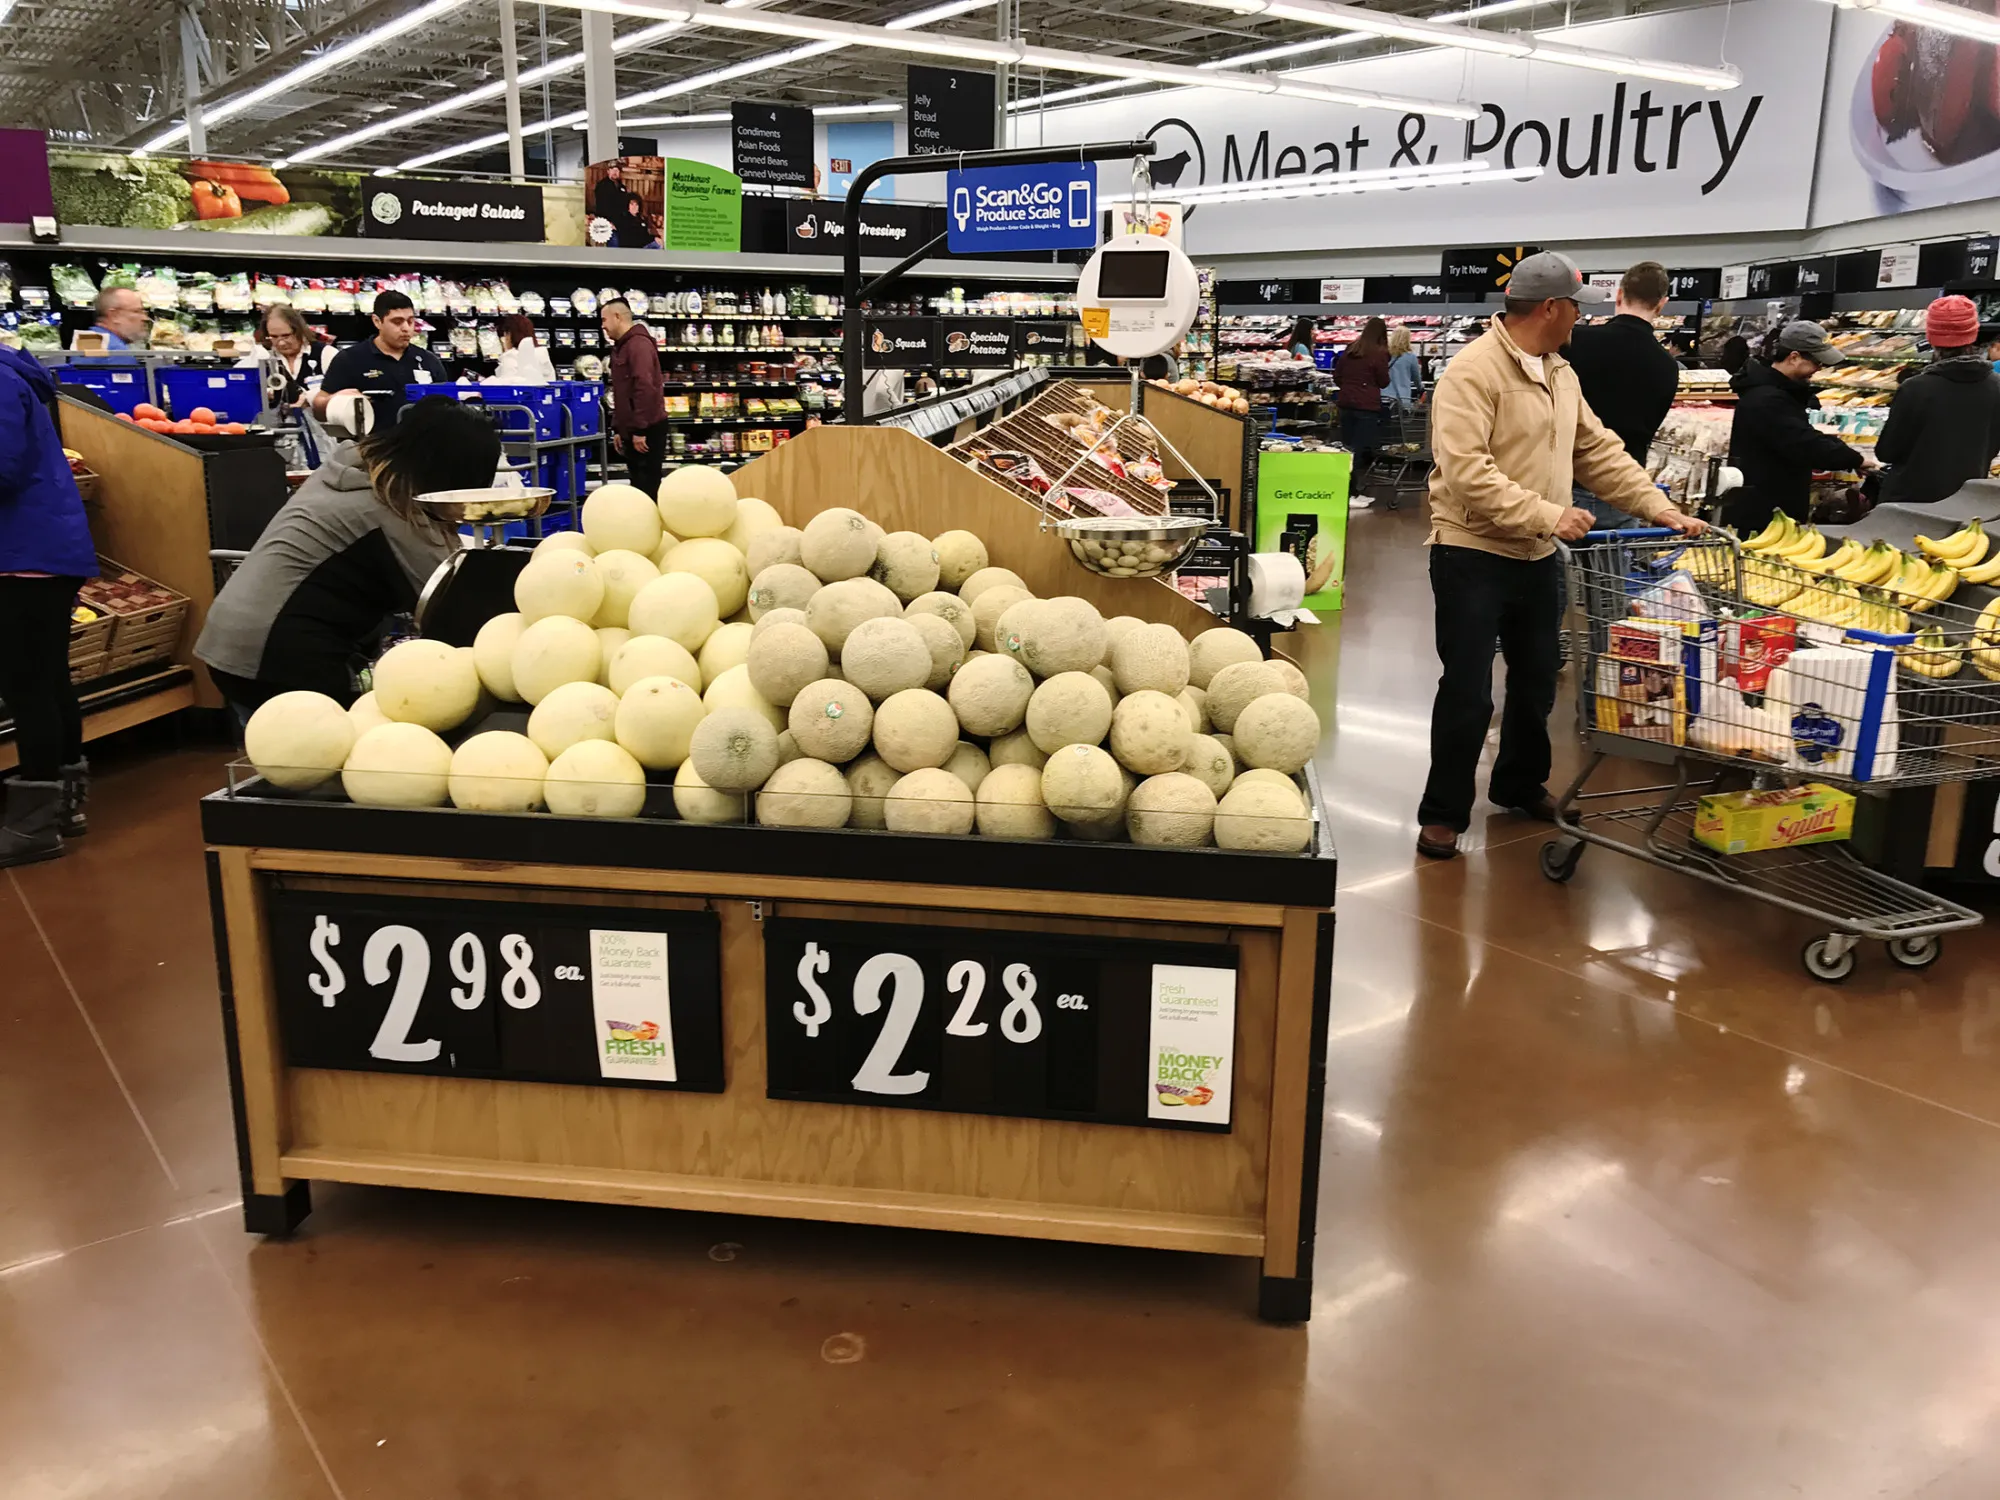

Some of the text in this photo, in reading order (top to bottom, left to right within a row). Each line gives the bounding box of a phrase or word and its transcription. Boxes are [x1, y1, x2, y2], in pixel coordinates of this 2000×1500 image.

[949, 78, 957, 89] 2
[914, 94, 931, 107] Jelly
[769, 111, 777, 122] 4
[914, 110, 937, 123] Bread
[737, 125, 781, 139] Condiments
[914, 126, 940, 139] Coffee
[618, 141, 625, 151] 6
[737, 140, 781, 152] Asian Foods
[914, 142, 937, 154] Snack
[1222, 82, 1764, 204] Meat & Poultry
[737, 153, 789, 166] Canned Beans
[834, 159, 849, 173] EXIT
[671, 171, 710, 184] Matthews
[738, 167, 806, 182] Canned Vegetables
[671, 182, 737, 196] Ridgeview Farms
[976, 182, 1063, 208] Scan&Go
[411, 199, 525, 222] Packaged Salads
[975, 205, 1061, 223] Produce Scale
[823, 220, 907, 241] Dips Dressings
[1449, 264, 1488, 277] Try It Now
[1592, 279, 1616, 288] FRESH
[895, 337, 927, 349] Squash
[969, 331, 1010, 344] Specialty
[969, 344, 1007, 355] Potatoes
[1274, 489, 1293, 500] Get
[1772, 803, 1839, 843] Squirt
[600, 934, 627, 945] 100%
[599, 946, 660, 959] Money Back
[600, 956, 652, 969] Guarantee
[554, 964, 586, 981] ea.
[1159, 982, 1186, 994] Fresh
[1056, 992, 1089, 1011] ea.
[1159, 994, 1219, 1008] Guaranteed
[605, 1039, 666, 1057] FRESH
[1158, 1052, 1224, 1070] MONEY
[1157, 1066, 1204, 1082] BACK
